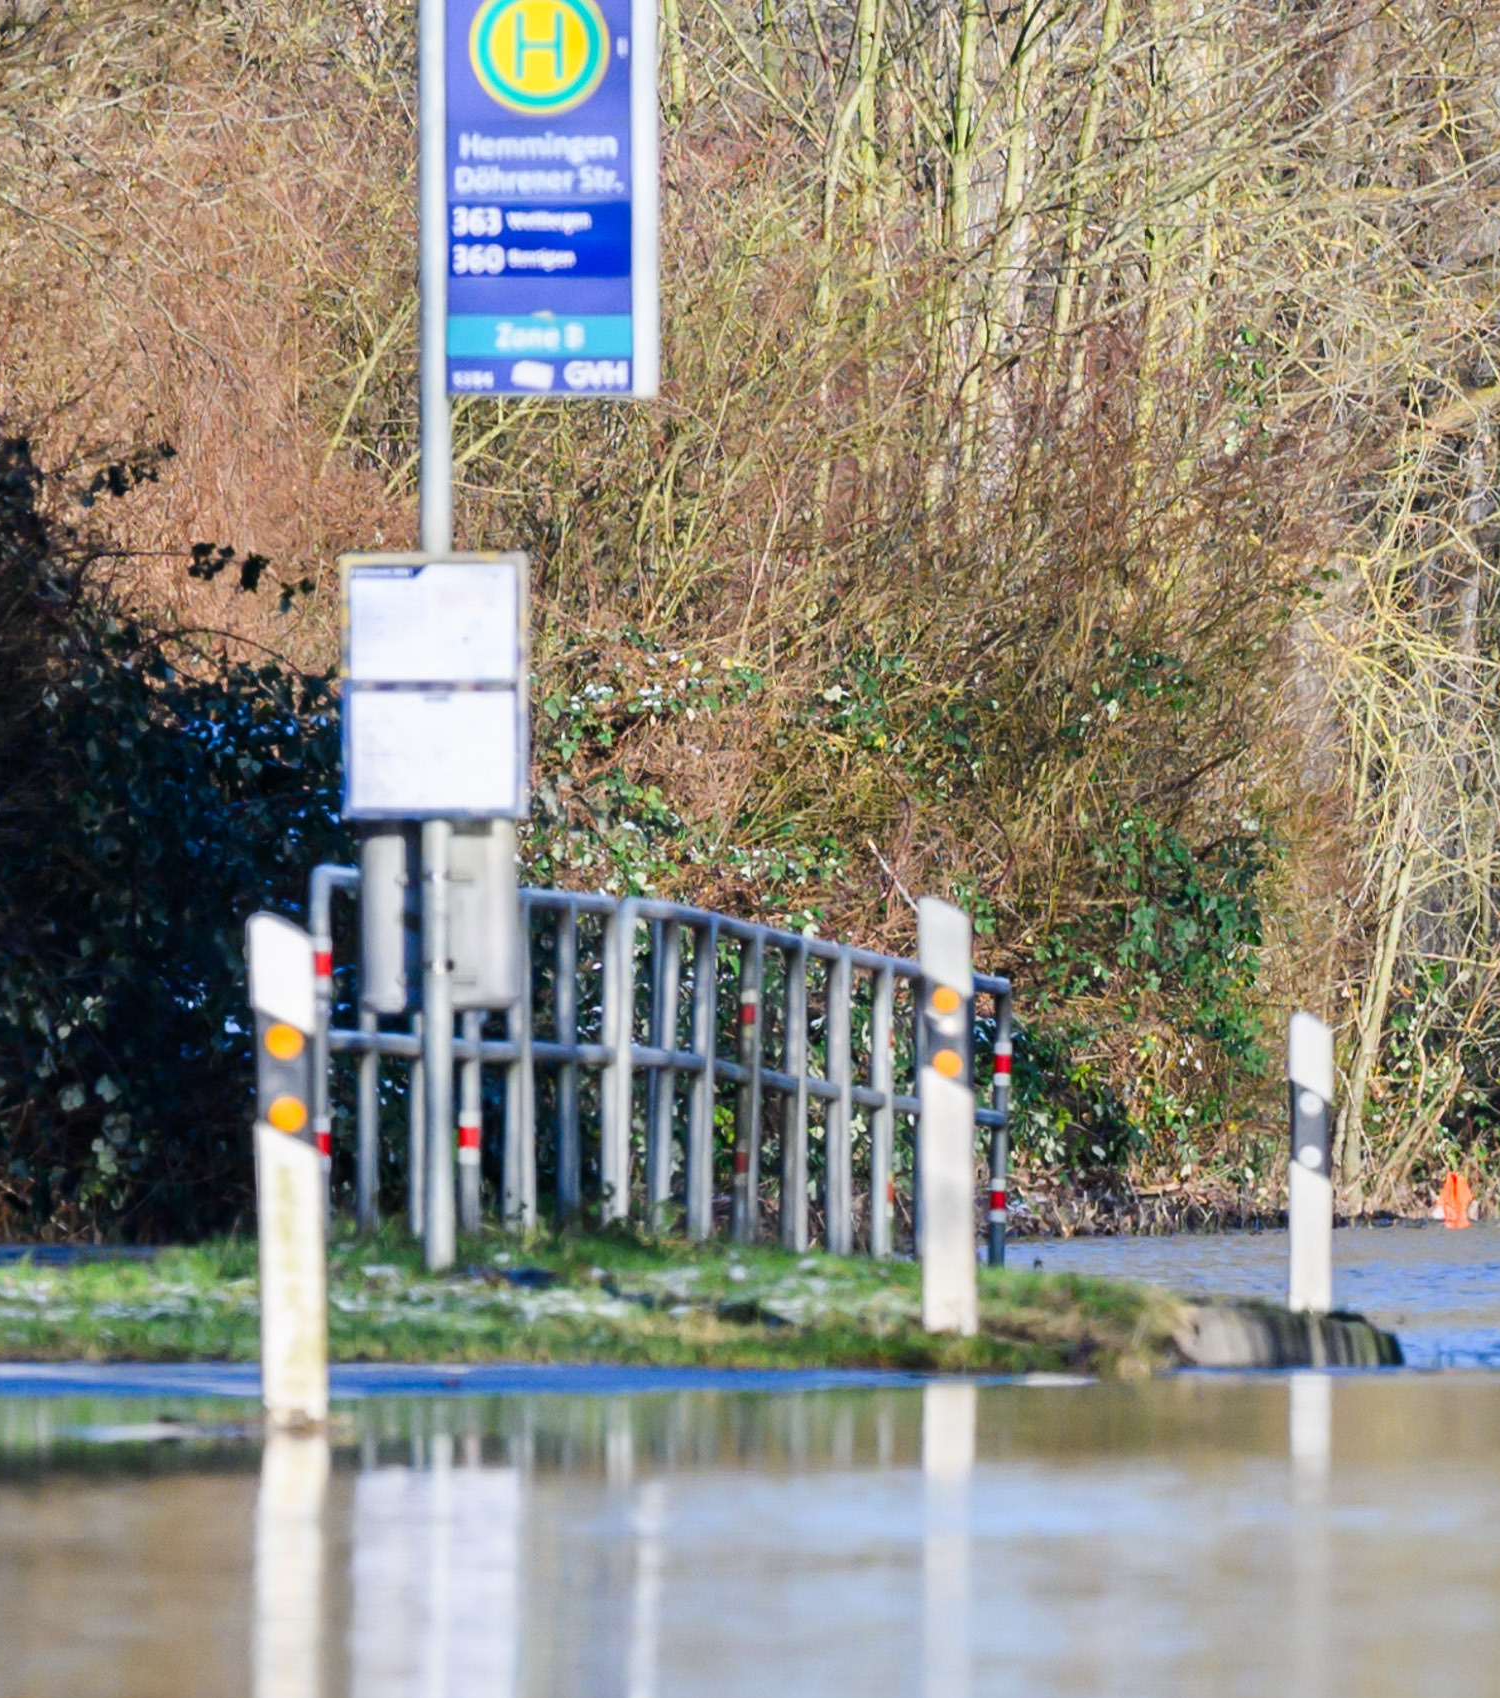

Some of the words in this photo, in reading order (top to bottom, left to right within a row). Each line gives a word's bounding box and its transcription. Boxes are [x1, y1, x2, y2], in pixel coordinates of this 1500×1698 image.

[458, 131, 618, 166] Hemmingen
[454, 165, 575, 195] Döhrener
[578, 165, 625, 194] Str.
[452, 206, 503, 237] 363
[452, 243, 506, 275] 360
[495, 322, 561, 350] Zone
[563, 360, 629, 390] GVH
